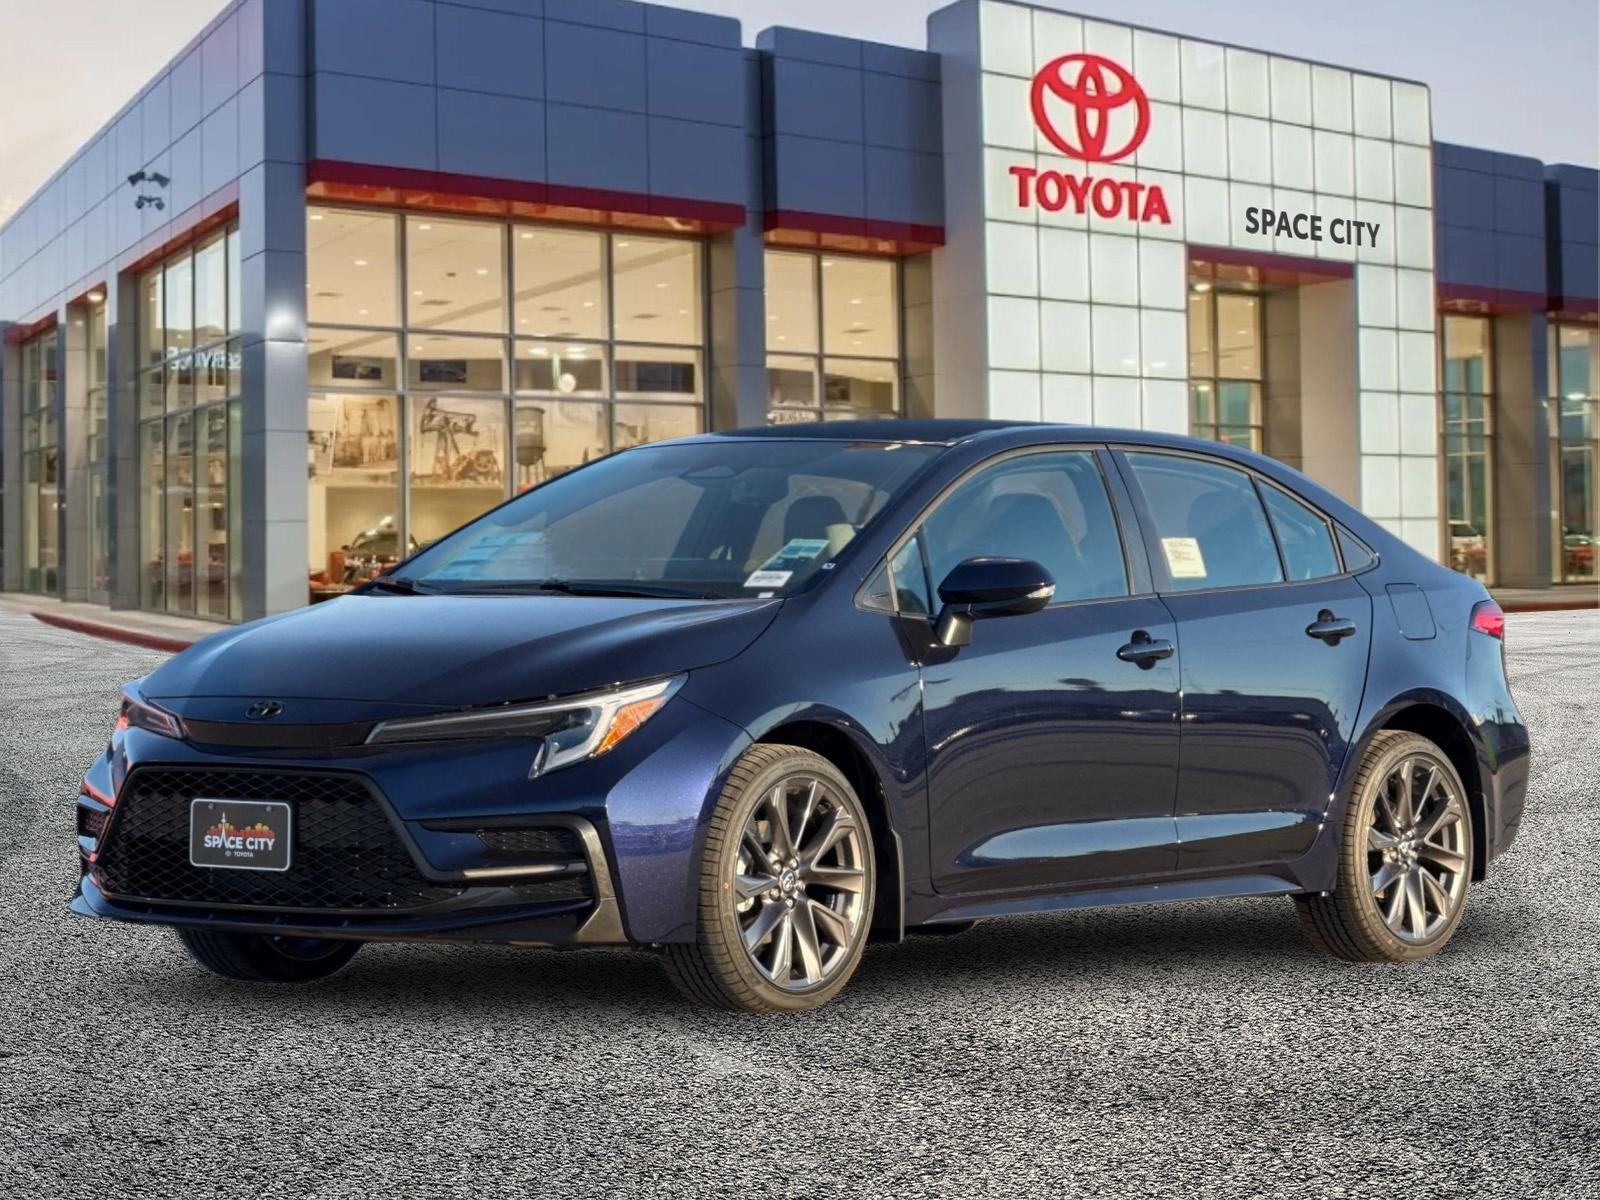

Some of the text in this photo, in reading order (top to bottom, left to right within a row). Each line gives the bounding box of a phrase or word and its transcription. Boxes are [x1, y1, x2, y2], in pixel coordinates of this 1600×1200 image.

[1009, 166, 1171, 224] TOYOTA
[1245, 206, 1381, 248] SPACE CITY
[203, 827, 275, 851] SPACE CITY
